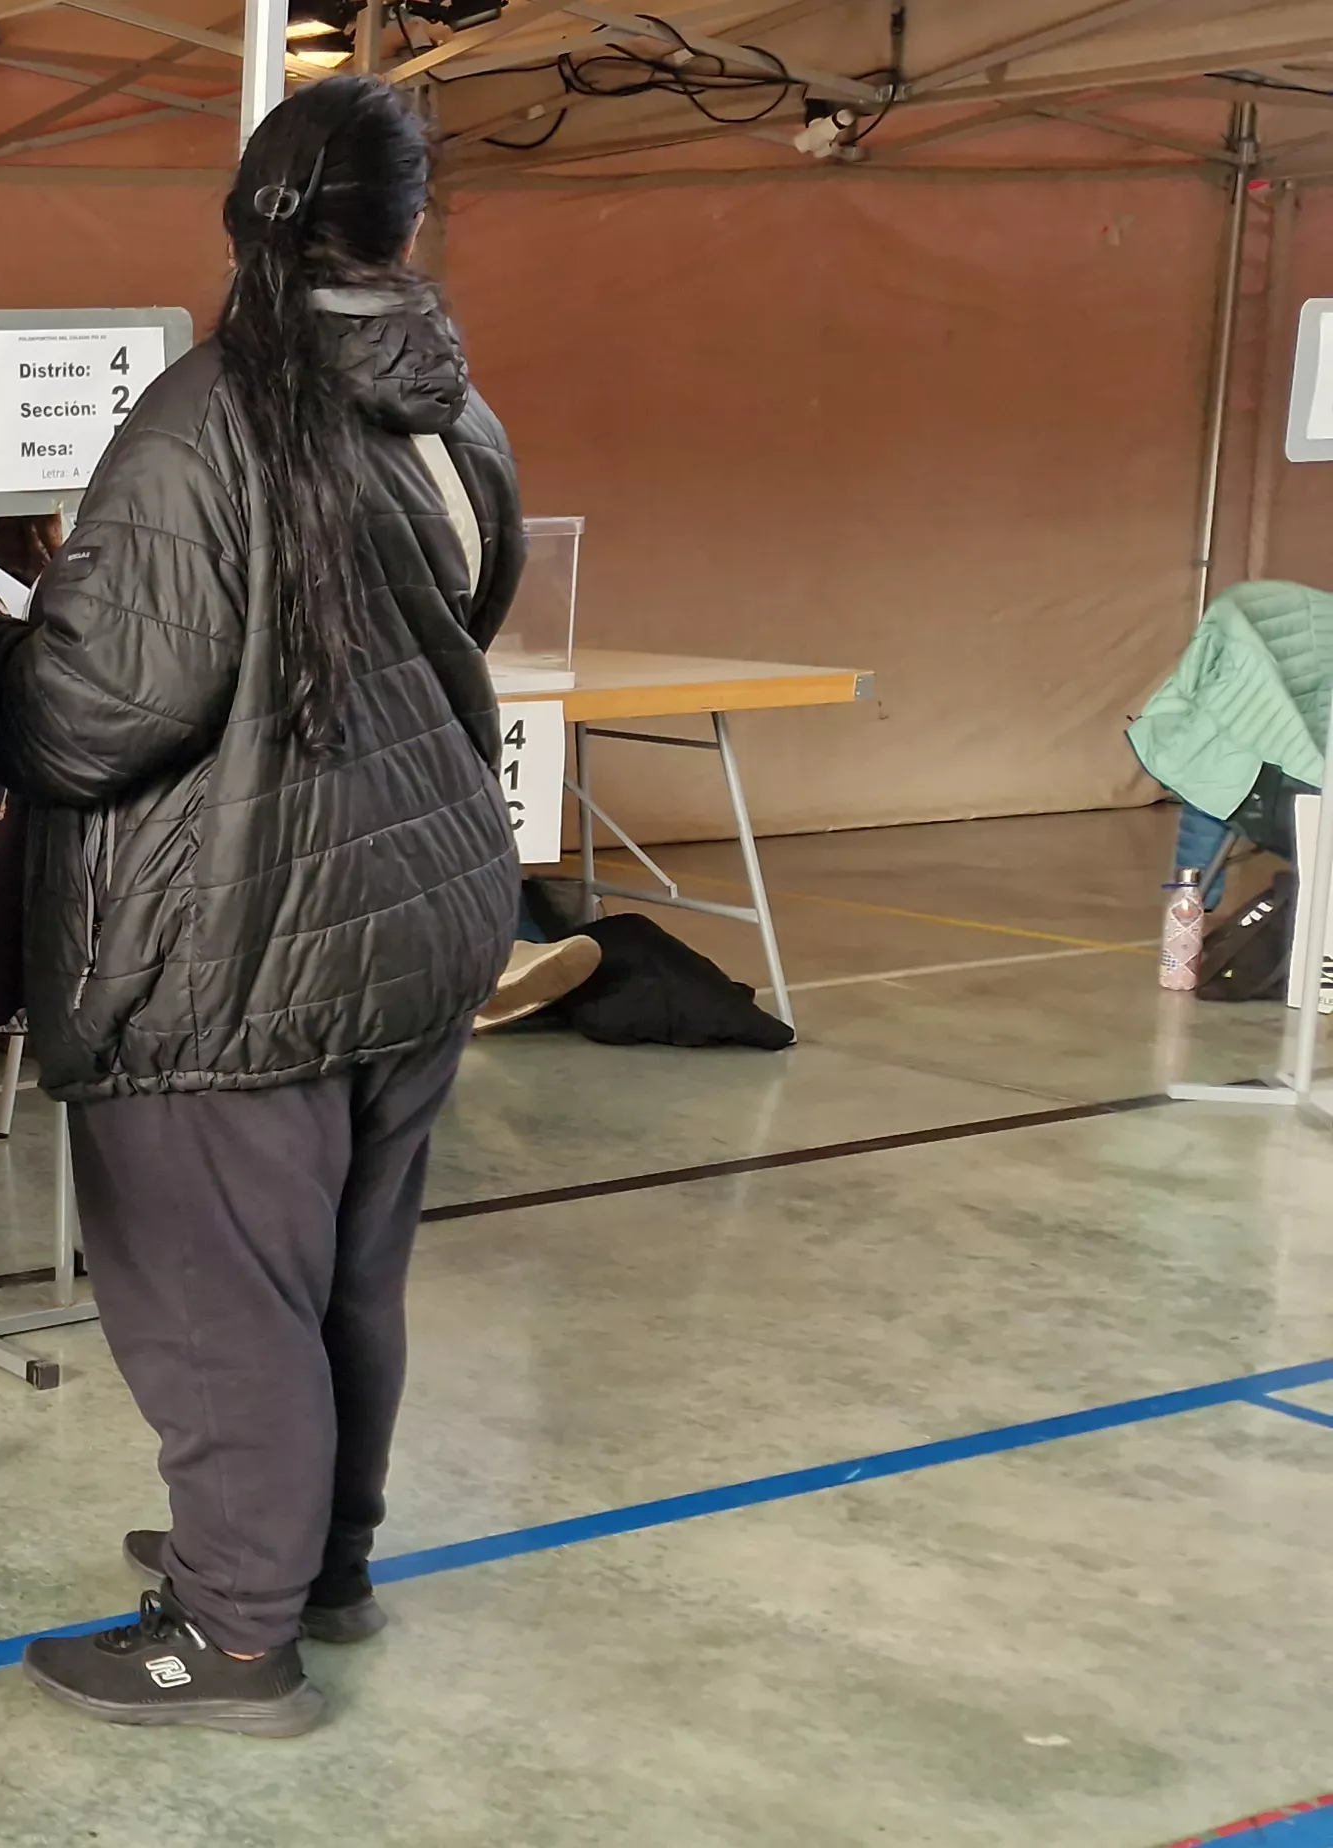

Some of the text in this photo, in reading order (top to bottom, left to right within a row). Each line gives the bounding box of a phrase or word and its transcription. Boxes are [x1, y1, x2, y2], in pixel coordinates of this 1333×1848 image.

[19, 346, 130, 379] Distrito: 4
[20, 385, 131, 419] Sección: 2
[21, 441, 73, 458] Mesa:
[42, 468, 69, 479] Letra:
[73, 467, 80, 477] A
[503, 720, 527, 750] 4
[504, 760, 519, 790] 1
[507, 800, 526, 831] C
